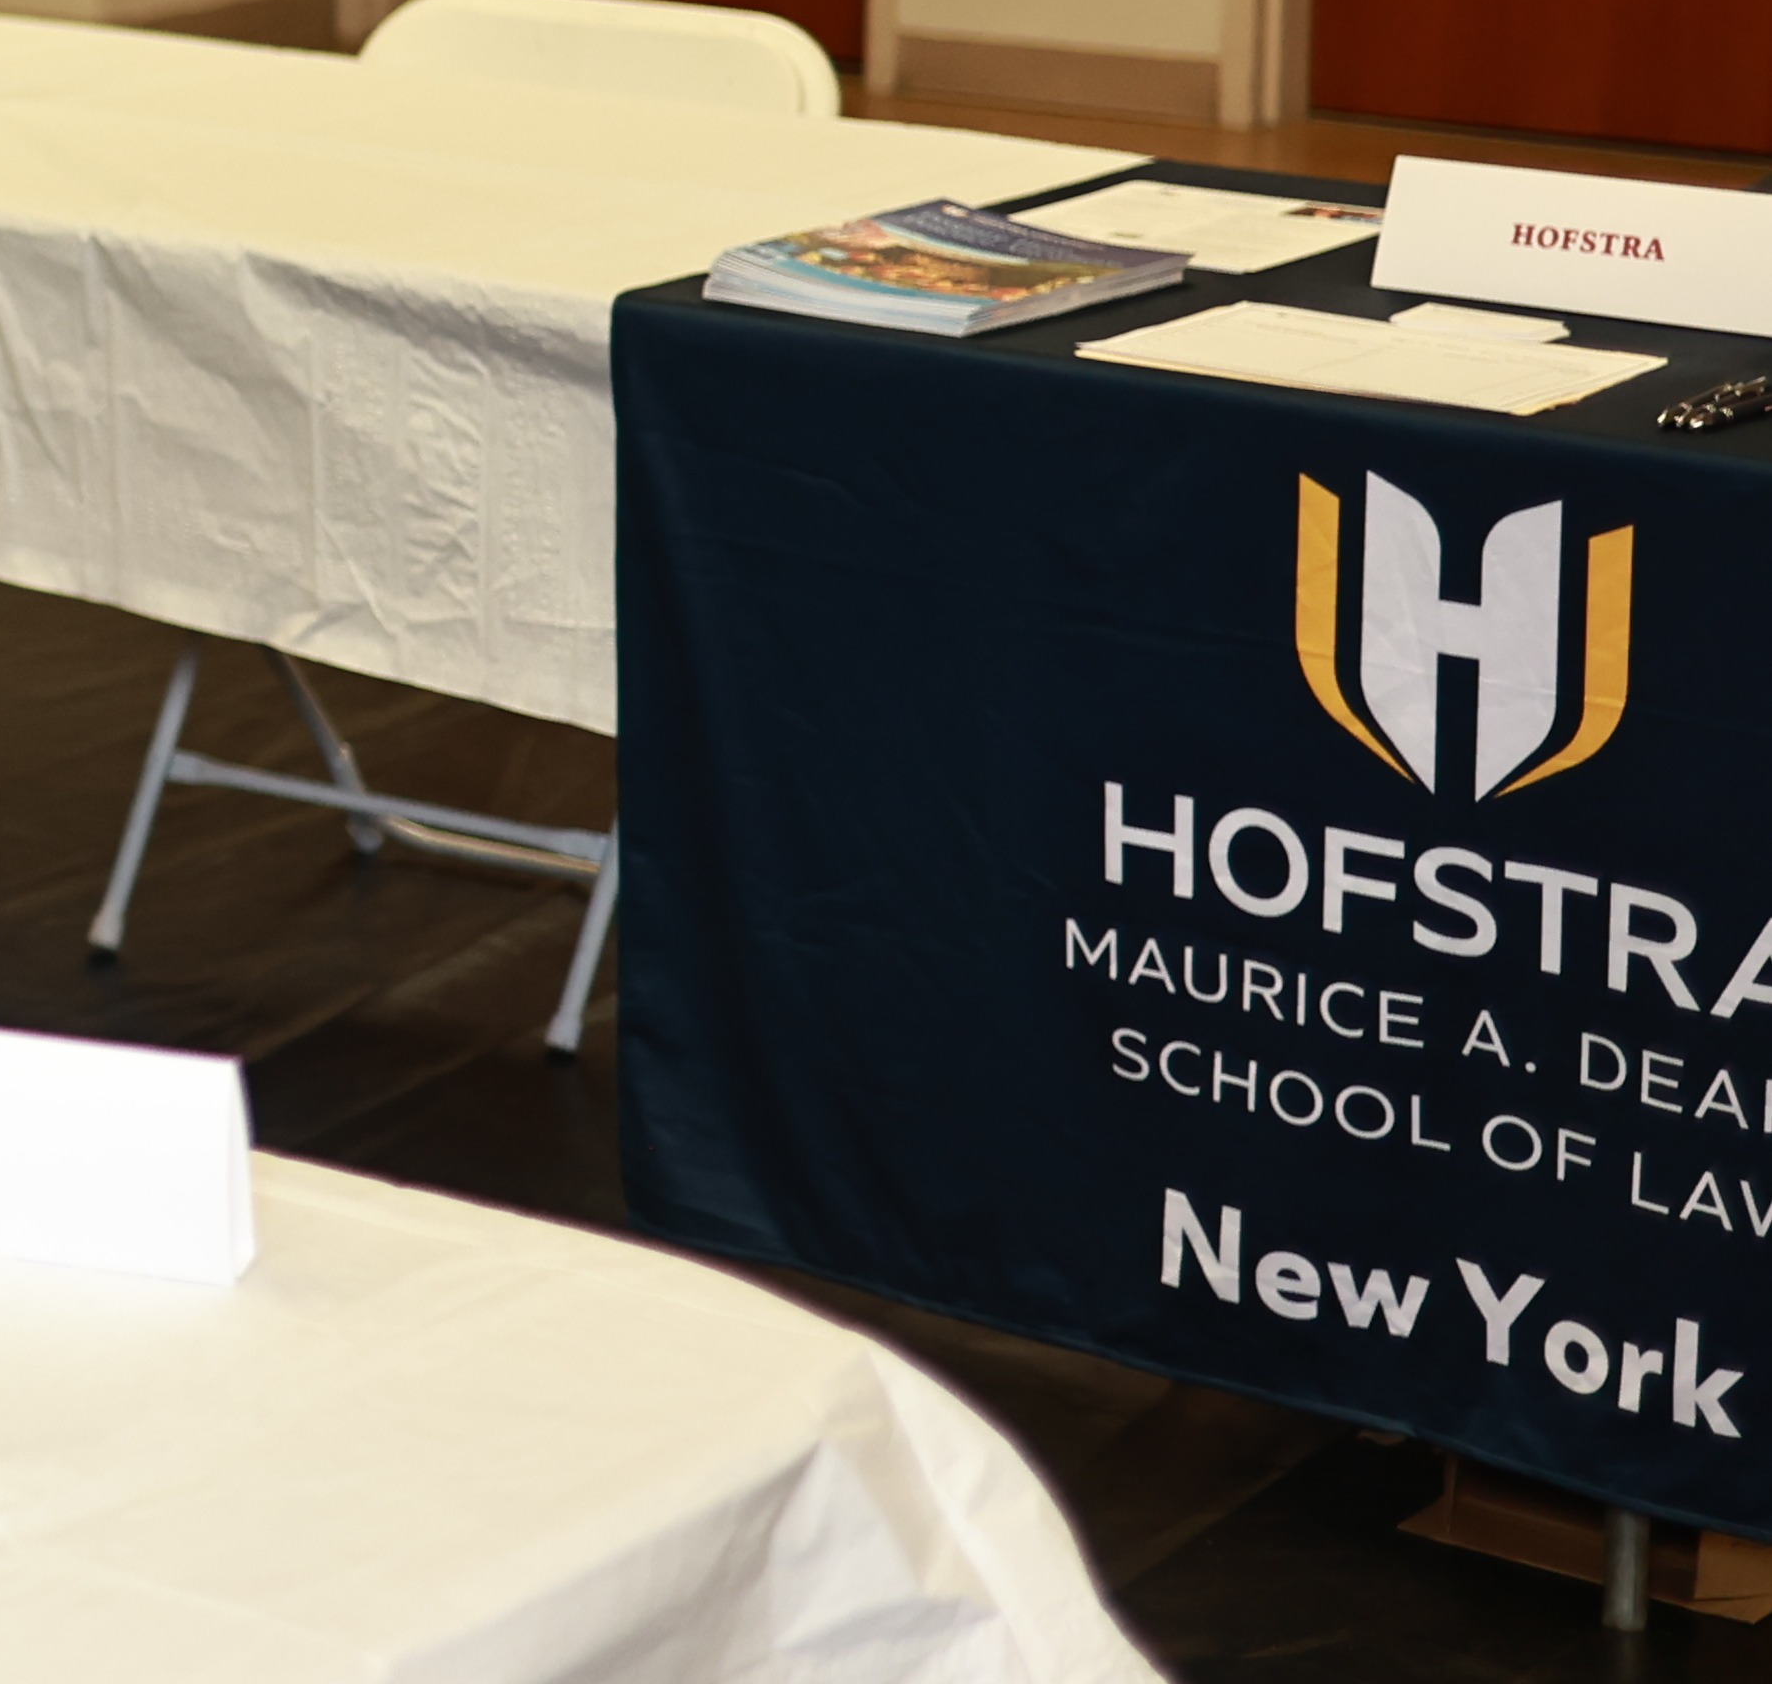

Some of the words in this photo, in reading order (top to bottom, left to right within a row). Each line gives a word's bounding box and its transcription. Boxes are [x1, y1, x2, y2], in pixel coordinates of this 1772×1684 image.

[1511, 223, 1665, 261] HOFSTRA
[1064, 918, 1425, 1048] MAURICE
[1461, 1009, 1538, 1074] A.
[1579, 1031, 1772, 1133] DEA
[1111, 1027, 1451, 1152] SCHOOL
[1482, 1114, 1597, 1182] OF
[1160, 1187, 1430, 1338] New
[1455, 1256, 1744, 1439] York
